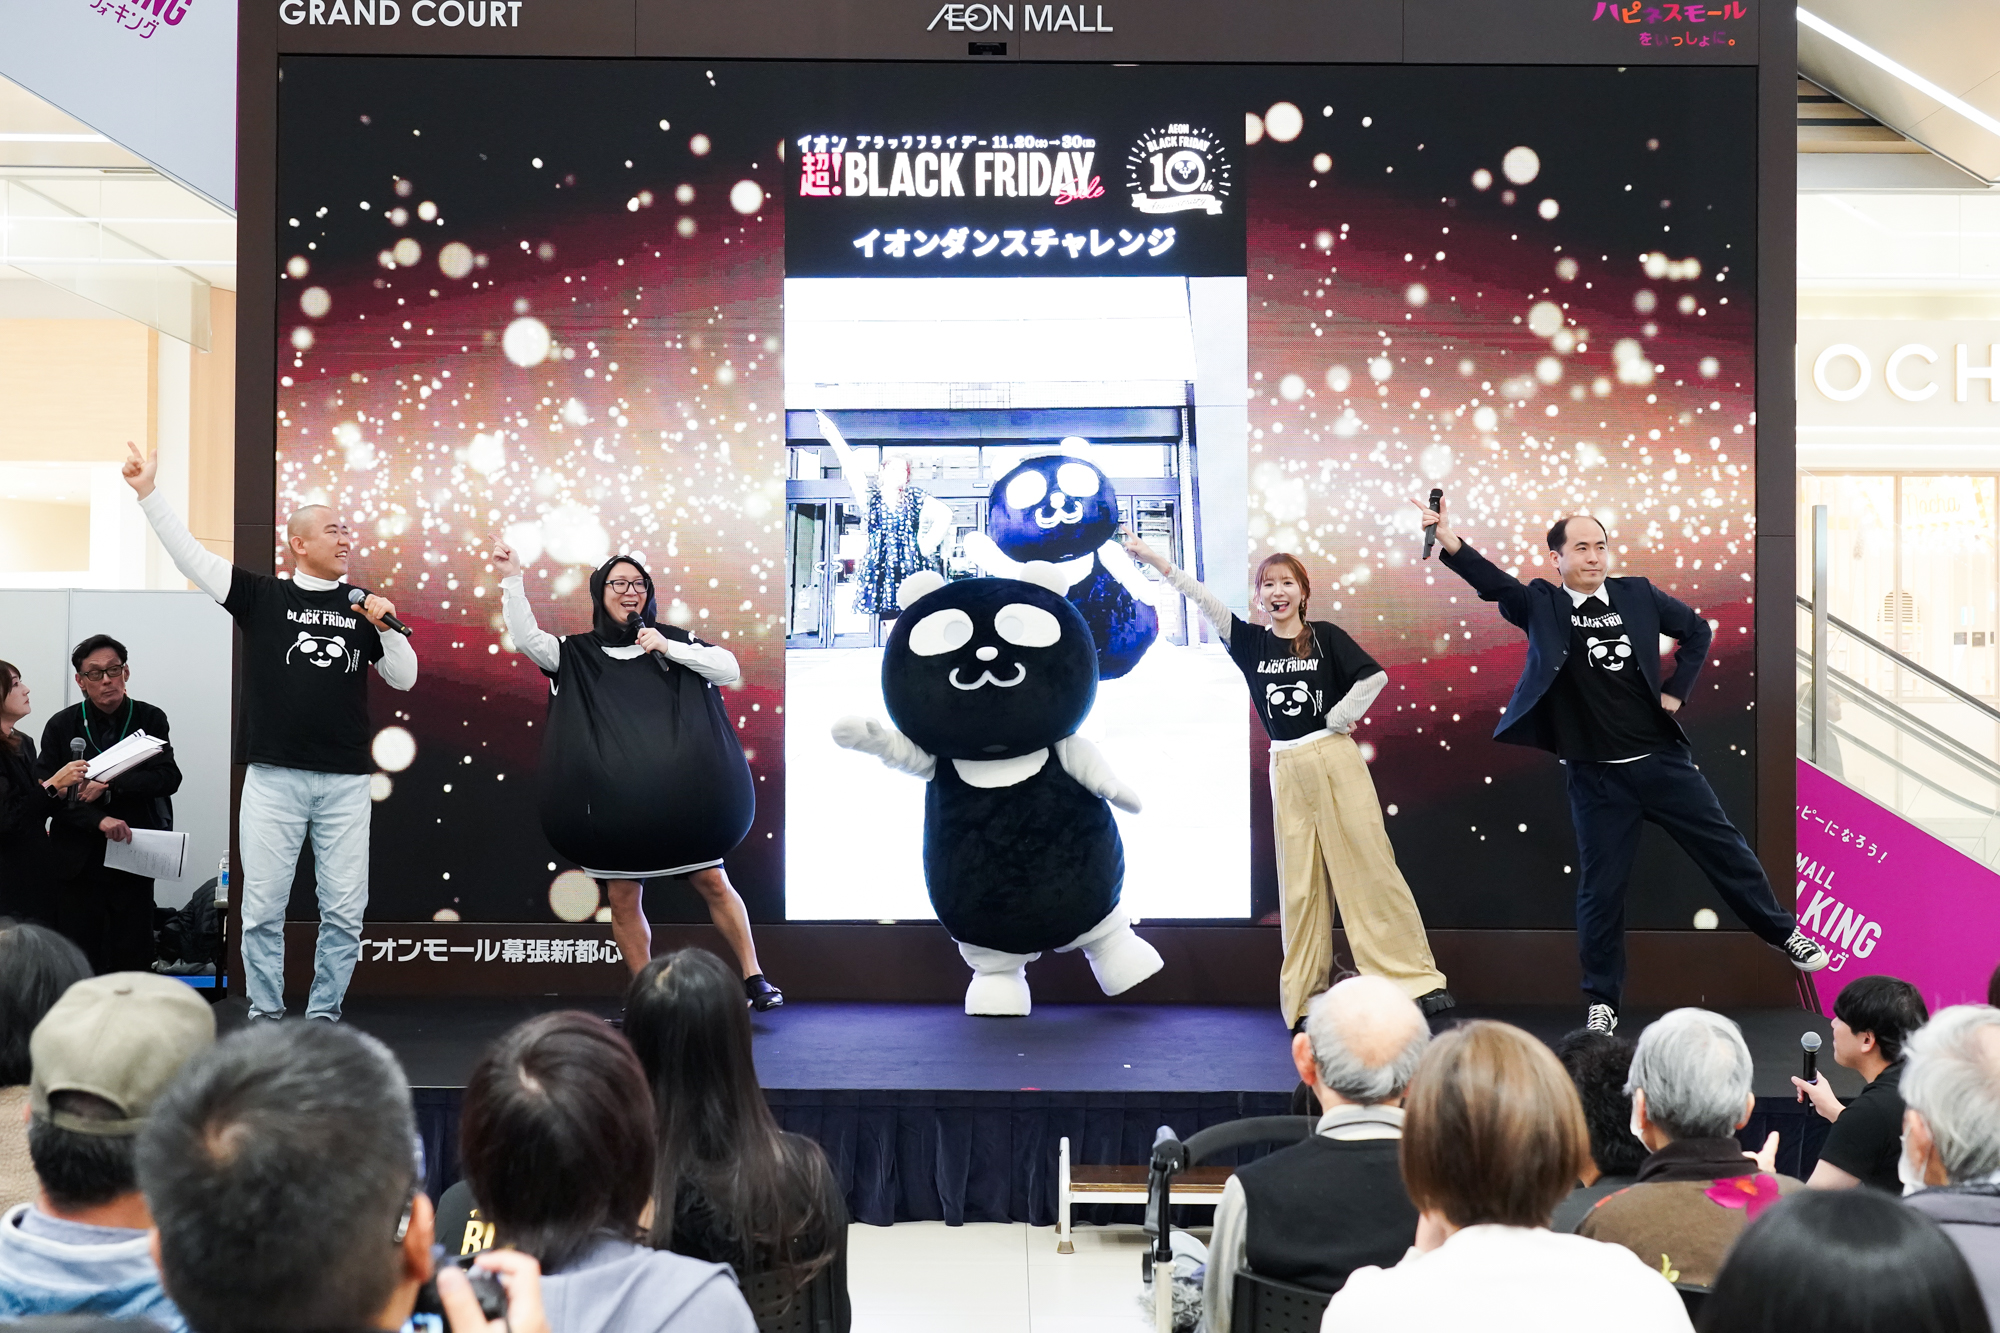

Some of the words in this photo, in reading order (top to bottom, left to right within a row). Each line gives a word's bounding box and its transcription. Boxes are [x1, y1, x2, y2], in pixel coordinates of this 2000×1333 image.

[90, 0, 160, 39] ォーキング
[279, 0, 400, 25] GRAND
[411, 0, 523, 27] COURT
[1024, 4, 1114, 32] MALL
[1592, 1, 1747, 24] ハピネスモール
[1639, 31, 1736, 47] をいっしょに。
[1168, 123, 1190, 135] AEON
[797, 134, 847, 153] イオン
[1146, 136, 1178, 153] BLACK
[1179, 136, 1211, 152] FRIDAY
[844, 151, 965, 197] BLACK
[975, 151, 1095, 198] FRIDAY
[853, 226, 1177, 259] イオンダンスチャレンジ
[1796, 343, 2000, 402] OCH
[286, 609, 321, 625] BLACK
[322, 613, 357, 630] FRIDAY
[1286, 658, 1319, 673] FRIDAY
[1796, 804, 1889, 864] ピーになろう!
